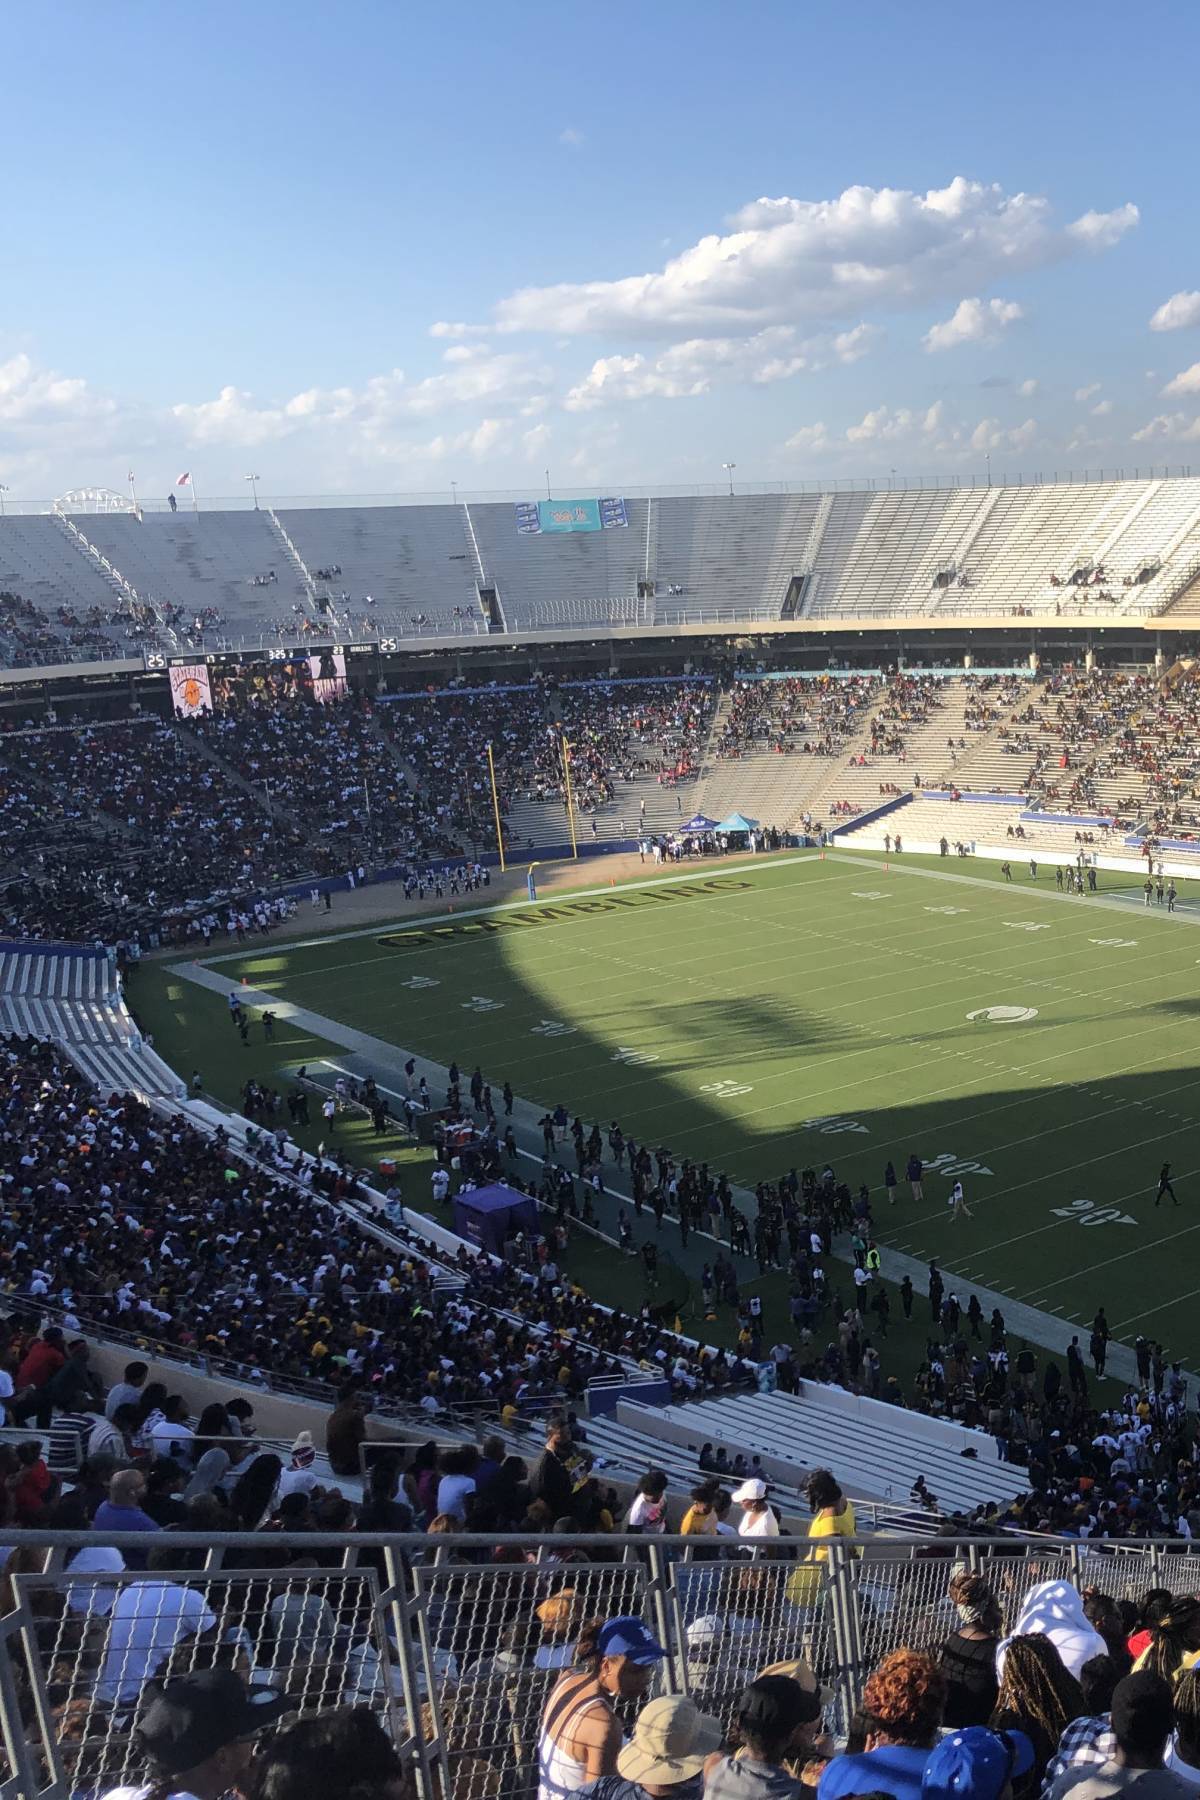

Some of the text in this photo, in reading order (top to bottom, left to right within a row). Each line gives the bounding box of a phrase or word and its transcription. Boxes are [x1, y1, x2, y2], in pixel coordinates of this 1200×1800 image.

[333, 646, 344, 655] 23
[381, 638, 396, 650] 25
[148, 654, 164, 667] 25
[269, 650, 286, 660] 3:25
[376, 880, 757, 948] GRAMBLING
[401, 978, 441, 989] 10
[699, 1080, 754, 1097] 50
[801, 1116, 860, 1134] 40
[921, 1154, 981, 1176] 30
[1050, 1199, 1121, 1226] 20
